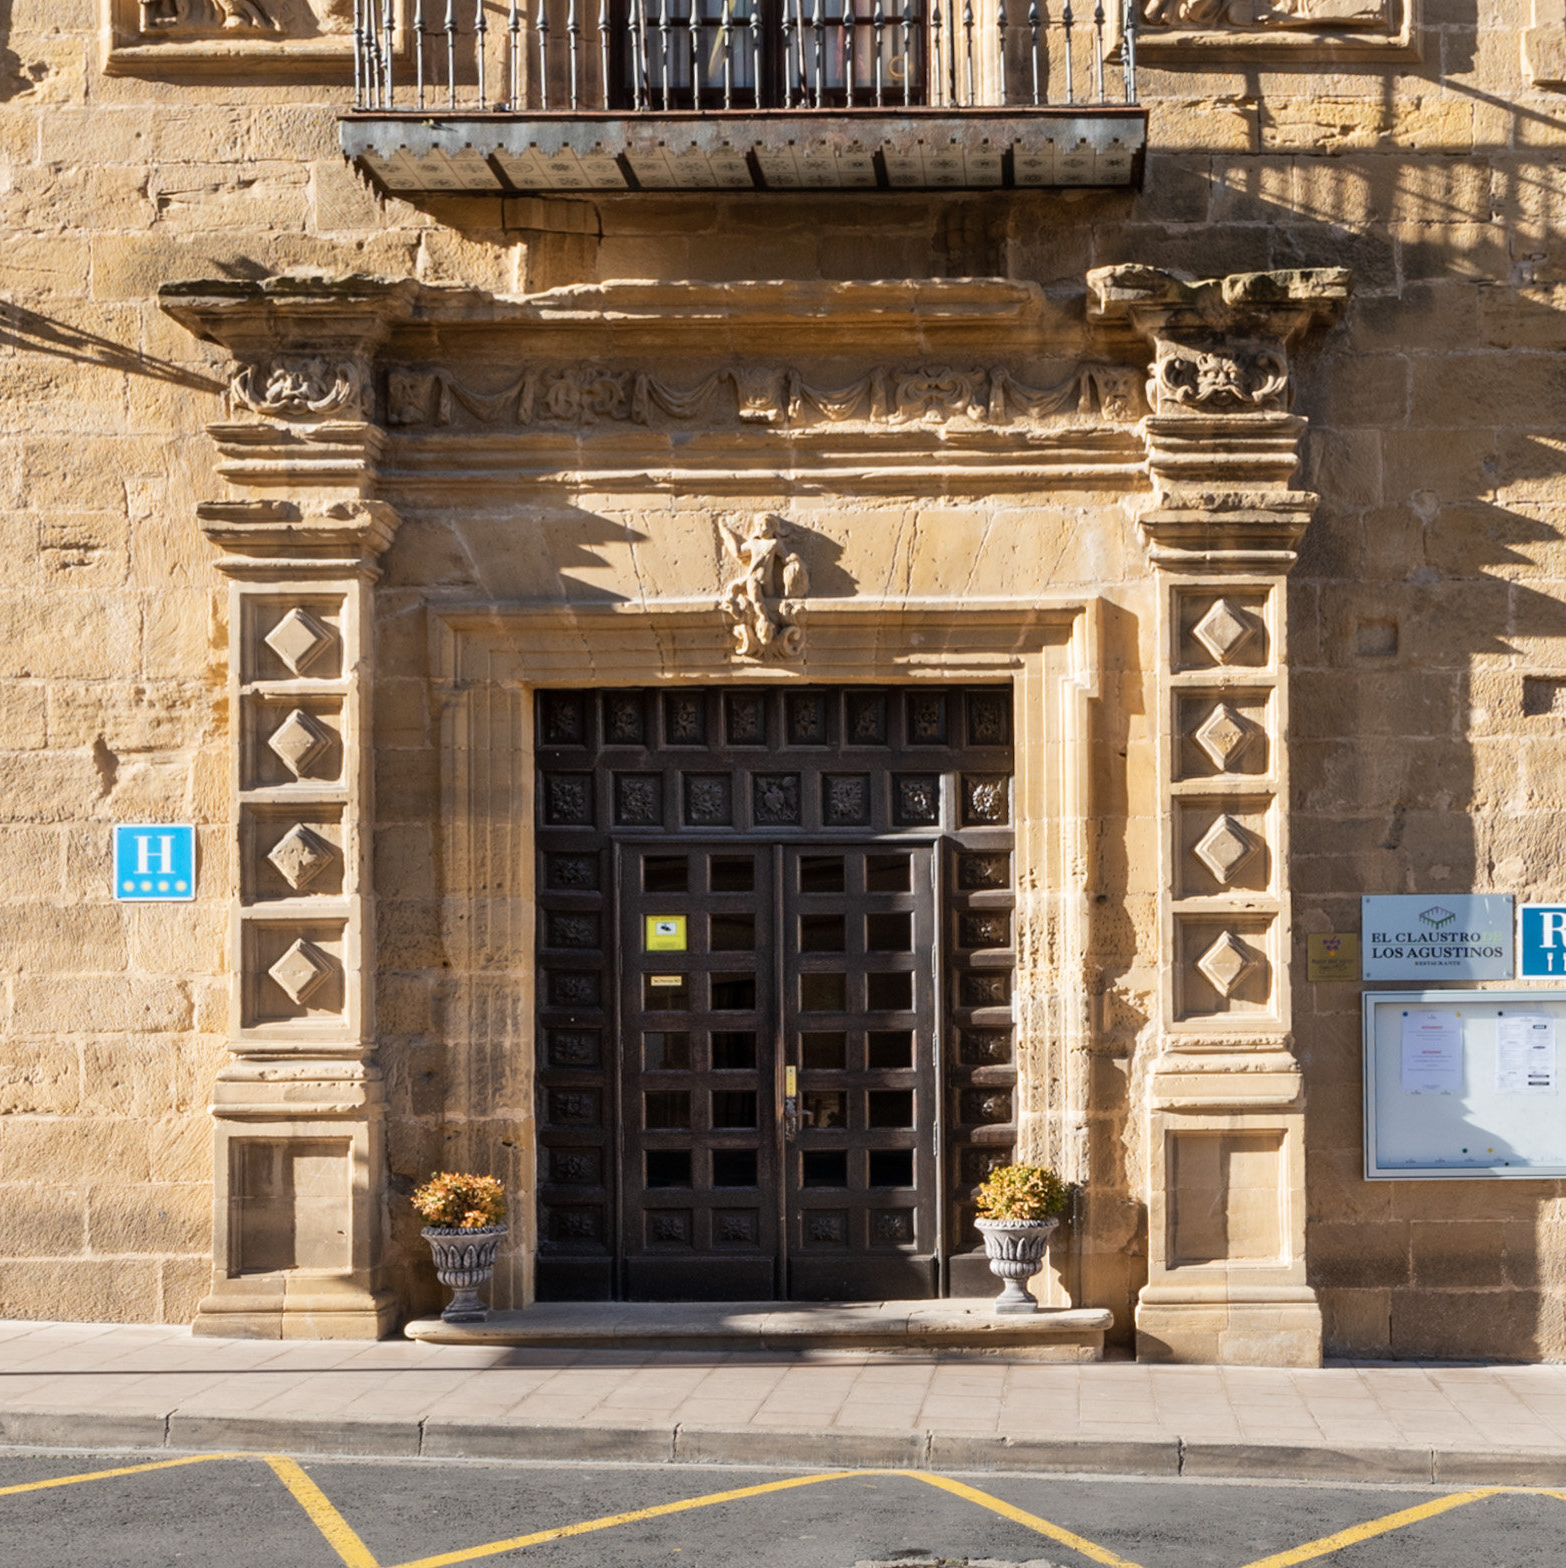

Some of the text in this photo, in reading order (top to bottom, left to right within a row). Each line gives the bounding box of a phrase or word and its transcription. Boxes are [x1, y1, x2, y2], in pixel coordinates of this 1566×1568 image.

[133, 835, 175, 874] H
[1371, 932, 1504, 943] EL CLAUSTRO DE
[1372, 946, 1504, 959] LOS AGUSTINOS
